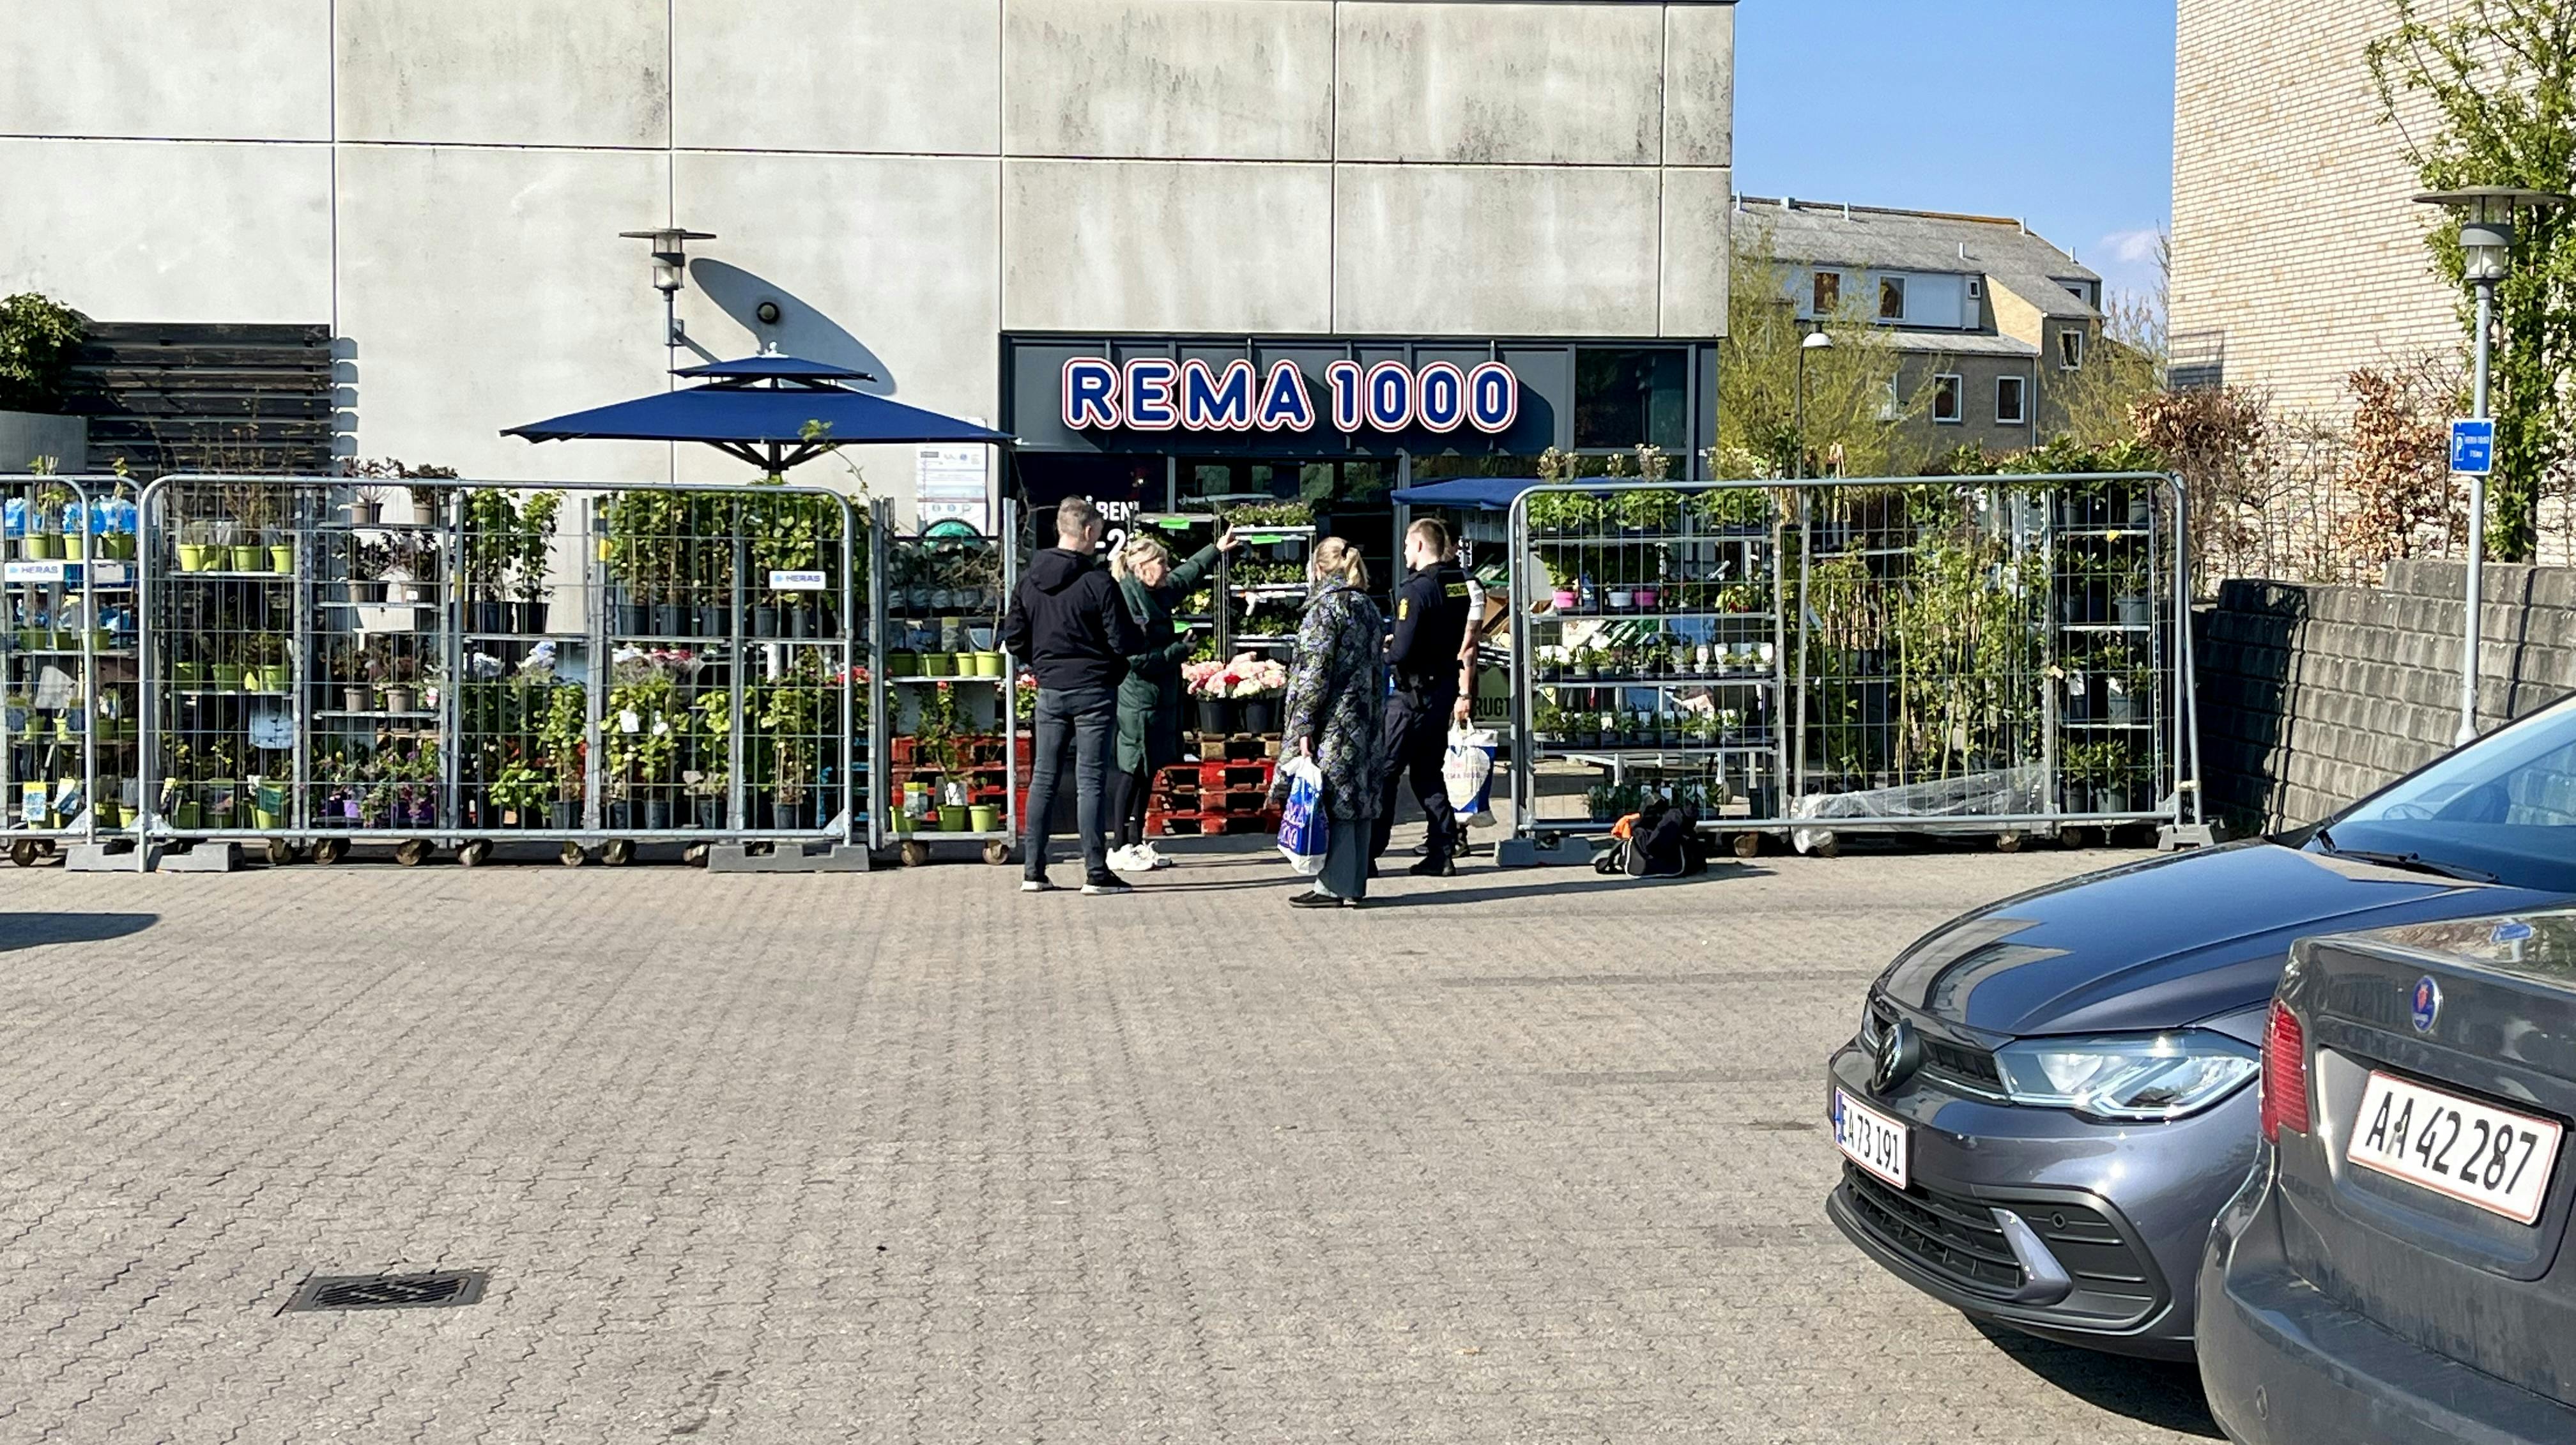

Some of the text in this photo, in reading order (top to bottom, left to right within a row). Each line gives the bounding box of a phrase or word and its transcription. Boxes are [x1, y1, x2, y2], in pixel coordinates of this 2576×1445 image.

[1062, 356, 1518, 434] REMA 1000
[21, 565, 58, 574] HERAS
[1475, 696, 1511, 717] RUGT
[1842, 1103, 1900, 1175] EA 73 191
[2365, 1091, 2540, 1195] AA 42 287
